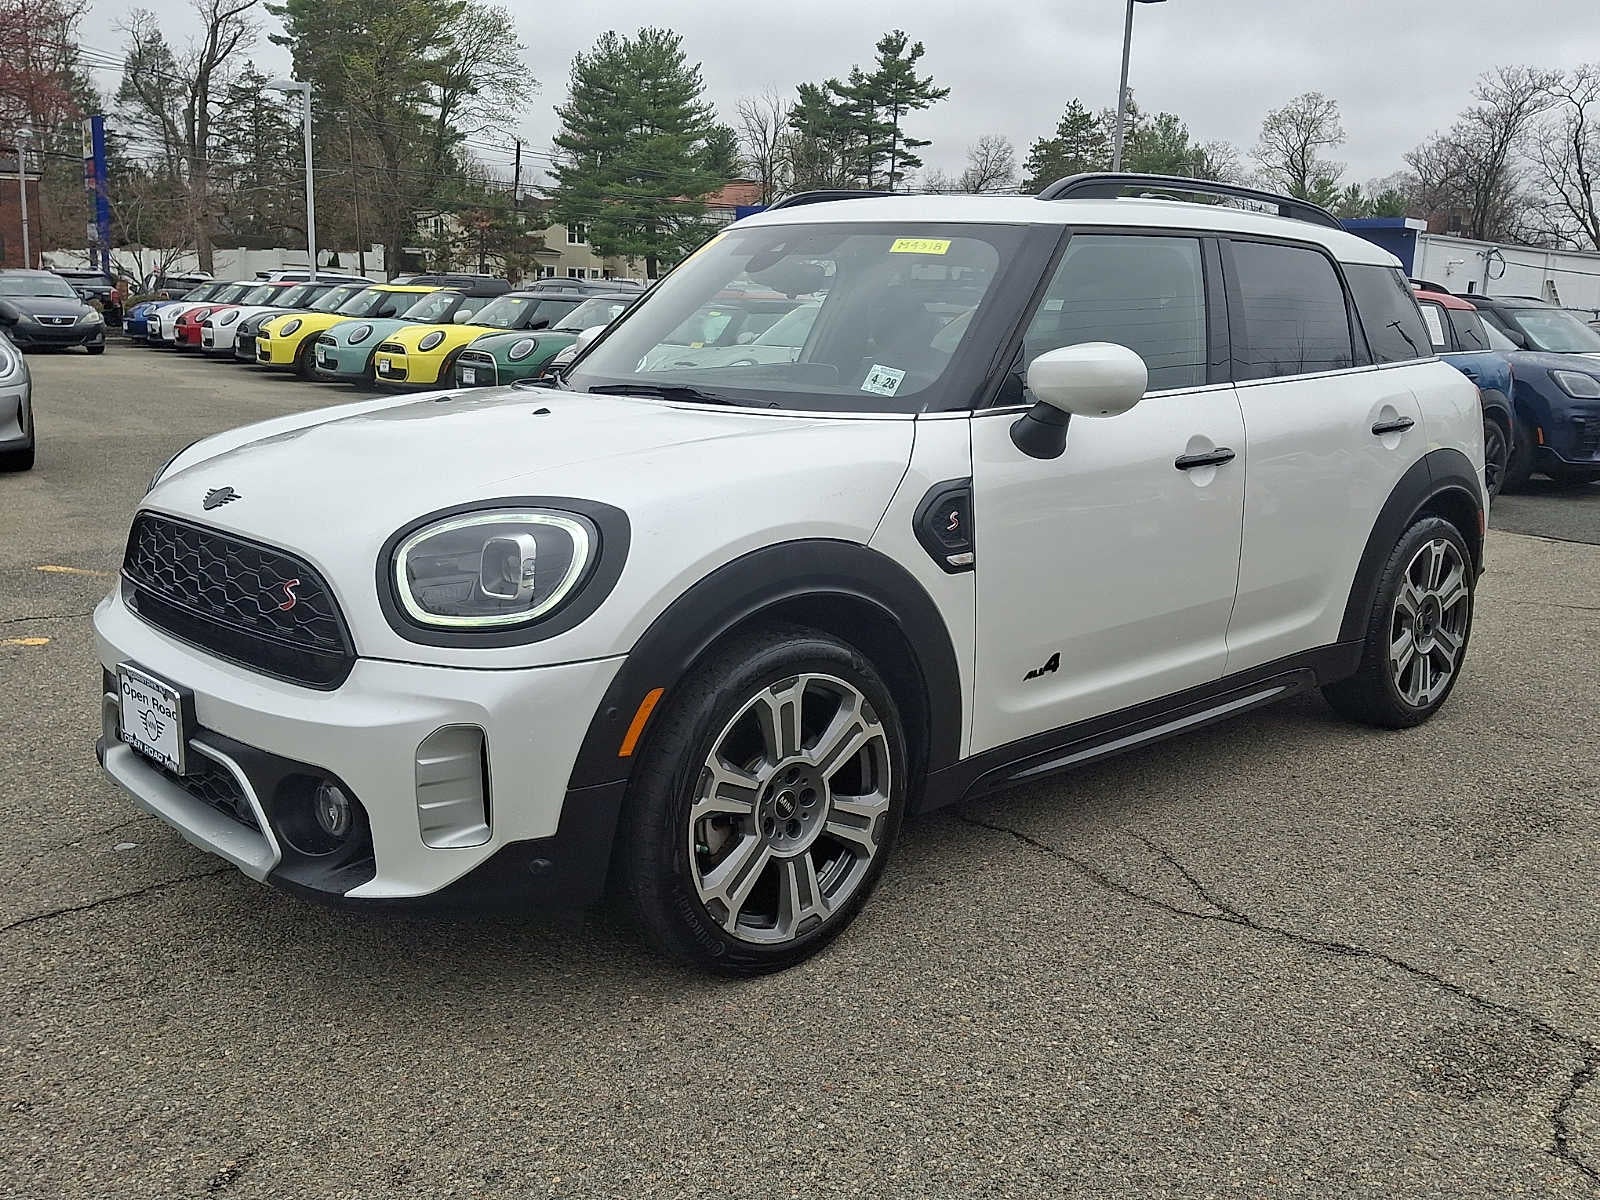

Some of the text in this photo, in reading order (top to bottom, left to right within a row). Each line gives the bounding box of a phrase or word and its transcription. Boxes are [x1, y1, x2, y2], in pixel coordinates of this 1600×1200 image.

[871, 374, 897, 389] 4 28
[947, 511, 959, 531] S
[279, 578, 300, 611] S
[123, 682, 149, 705] Open
[144, 745, 164, 762] ROAD
